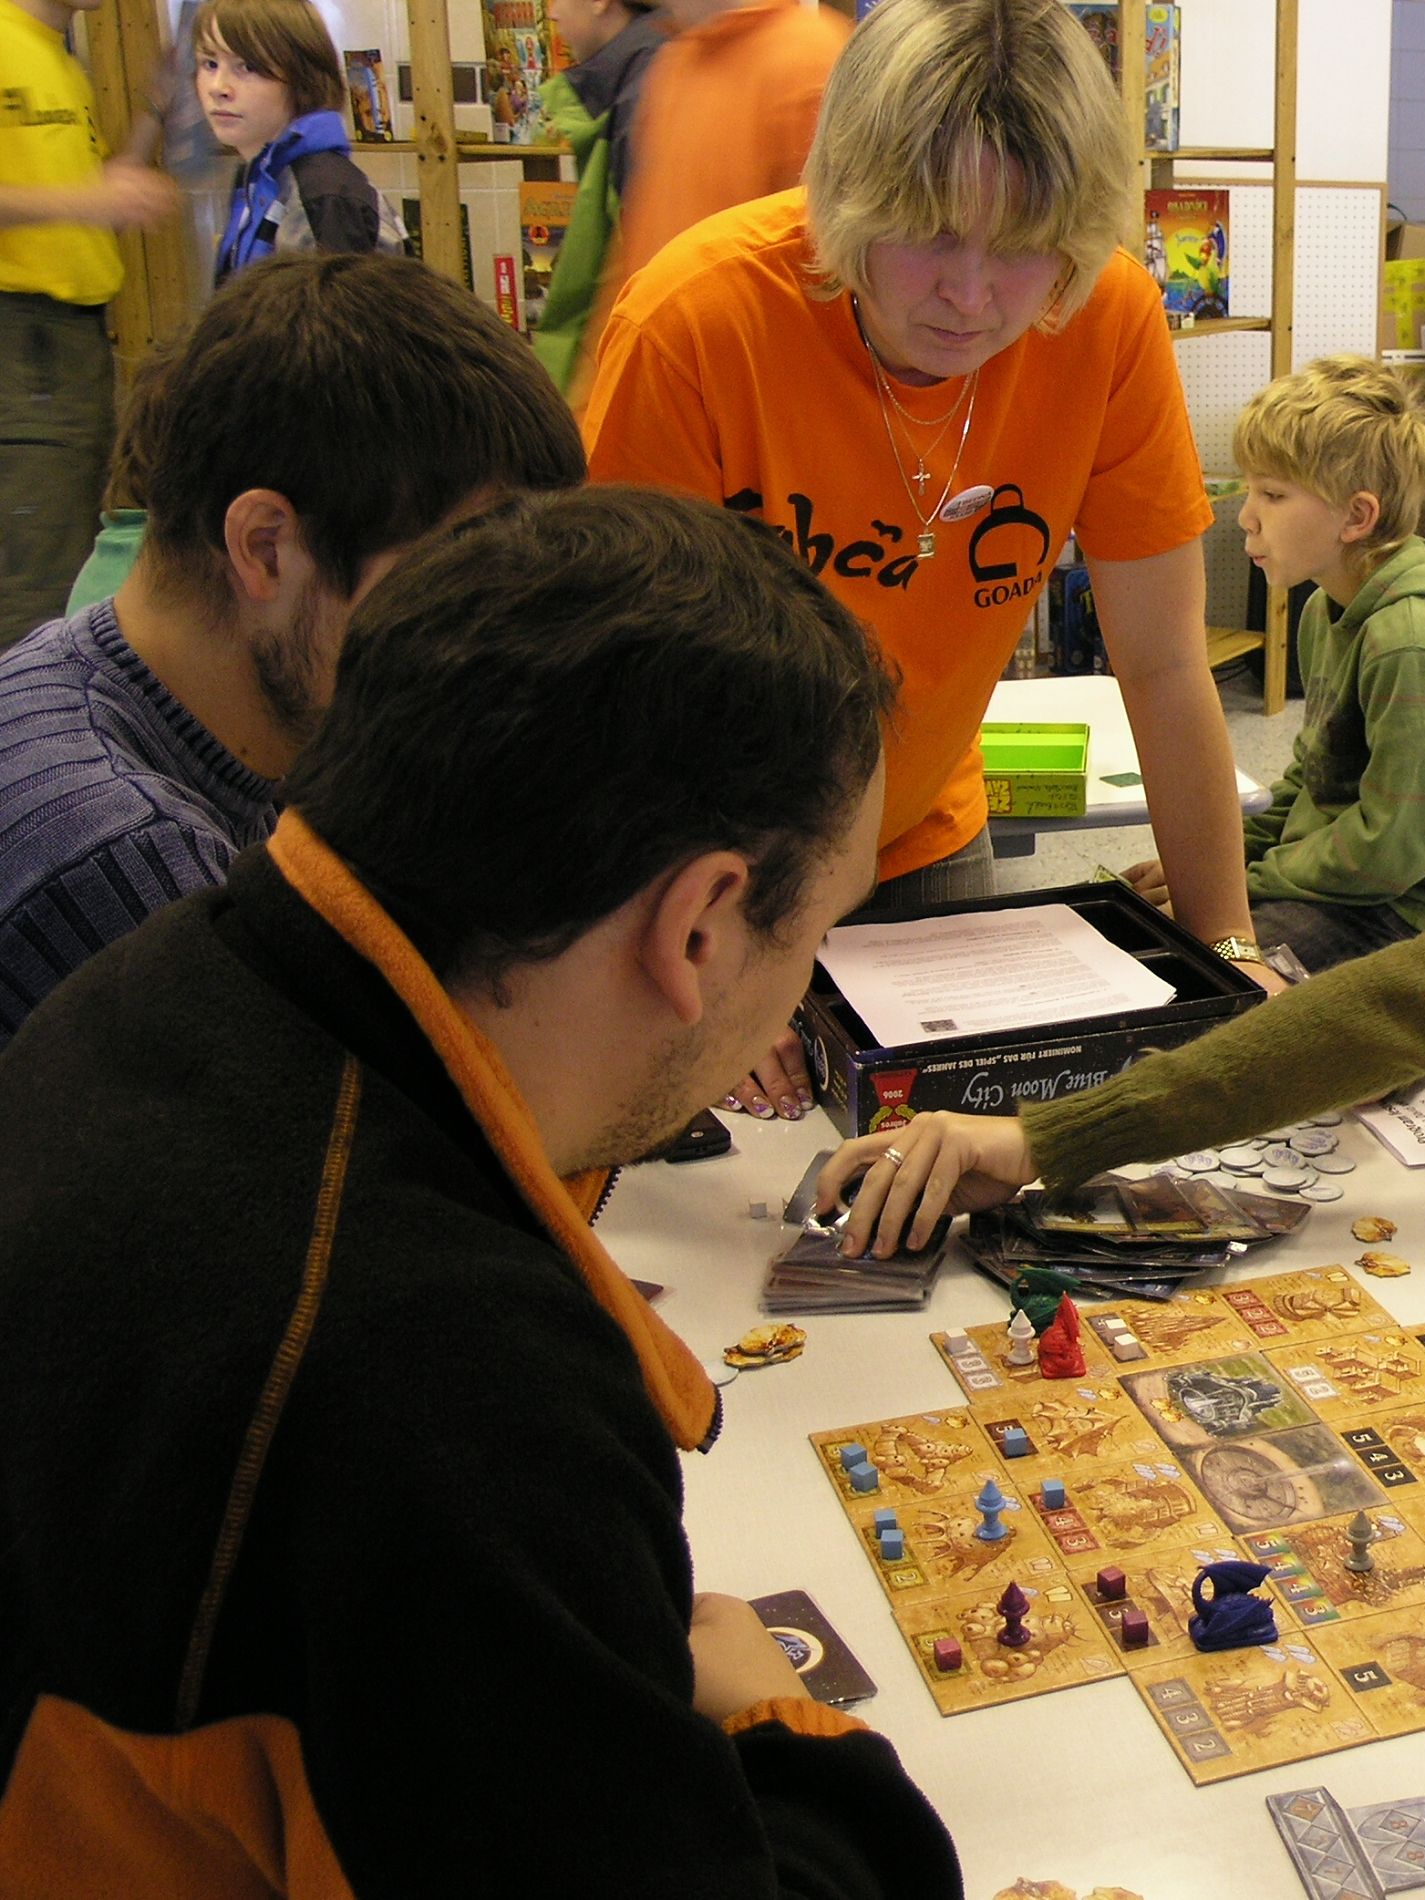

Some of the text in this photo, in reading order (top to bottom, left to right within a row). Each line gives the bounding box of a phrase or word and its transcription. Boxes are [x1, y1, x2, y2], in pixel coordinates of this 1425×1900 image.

[1020, 1051, 1036, 1064] FÜR
[1038, 1045, 1083, 1059] NOMINIERT
[958, 1060, 975, 1069] DES
[1003, 1054, 1019, 1064] DAS
[882, 1090, 904, 1100] 2006
[961, 1069, 1109, 1110] Blue Moon City
[1353, 1669, 1379, 1684] 5
[1161, 1687, 1216, 1752] 4 3 2
[1390, 1818, 1409, 1831] 8
[1406, 1850, 1425, 1863] 8
